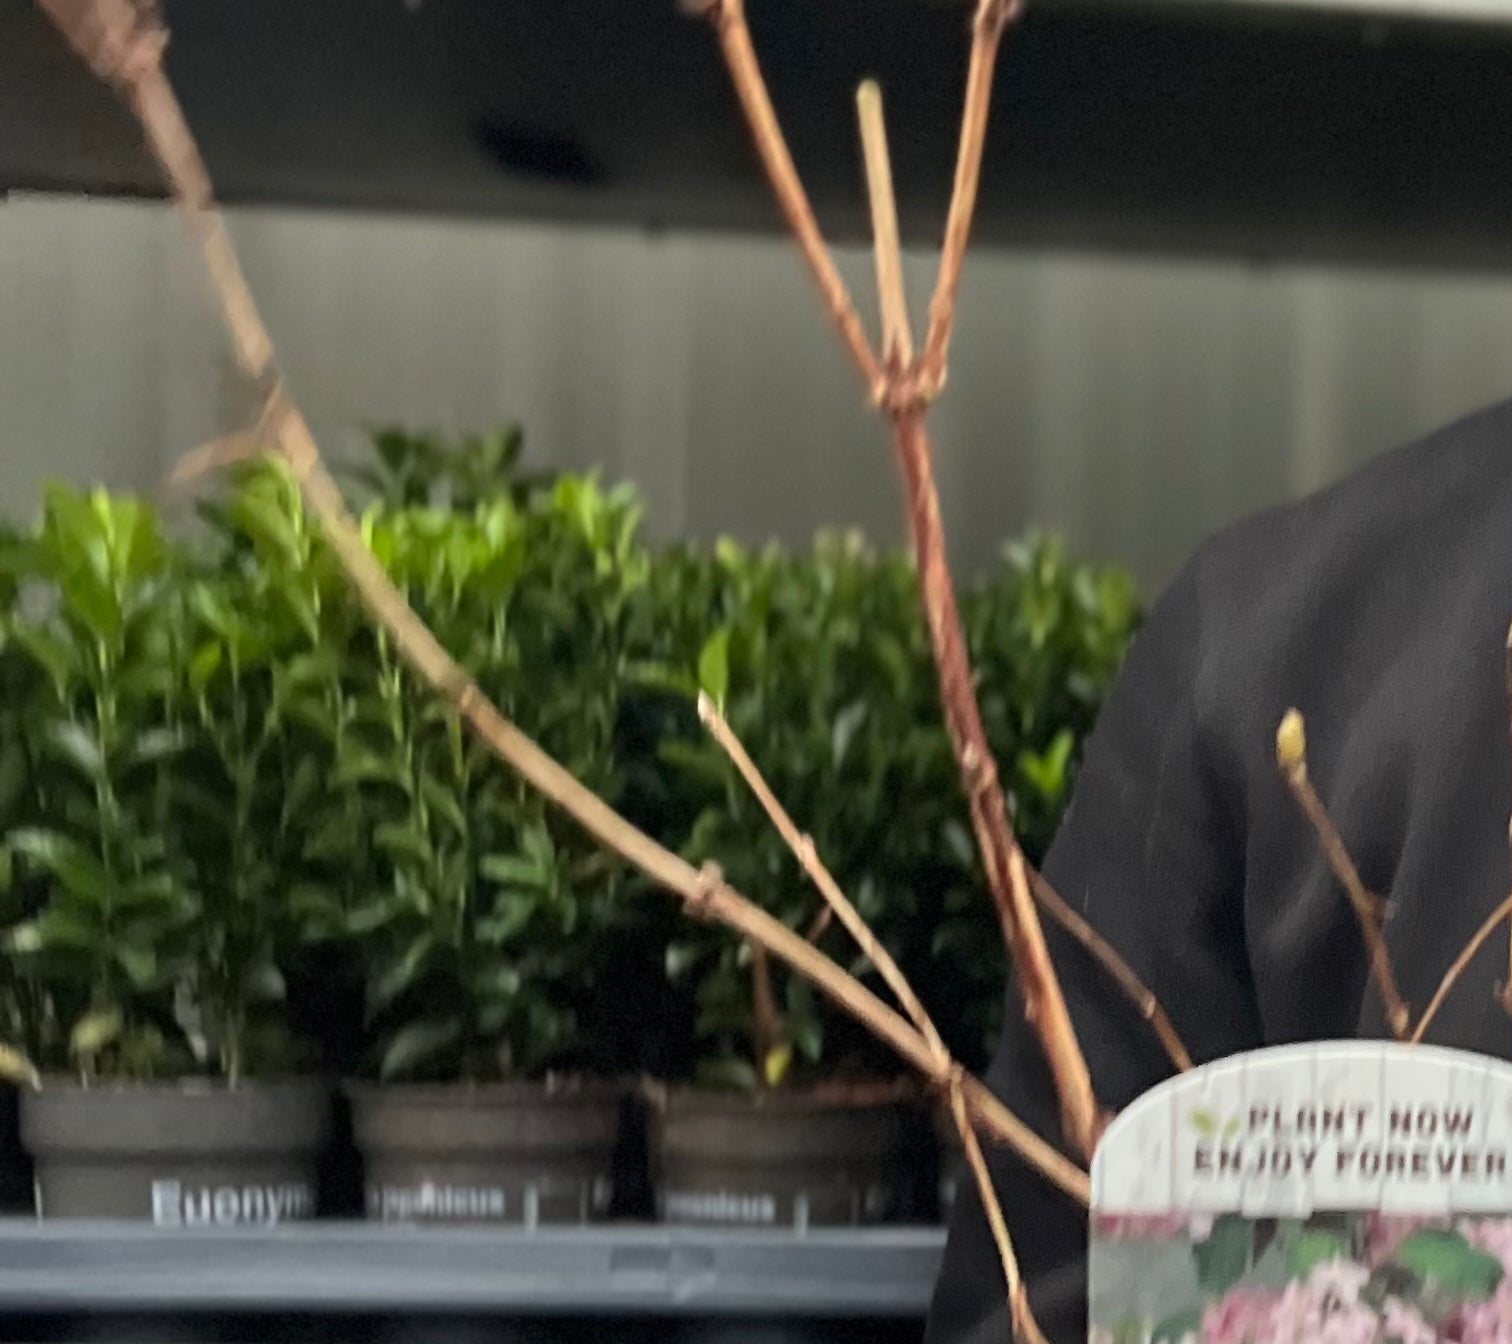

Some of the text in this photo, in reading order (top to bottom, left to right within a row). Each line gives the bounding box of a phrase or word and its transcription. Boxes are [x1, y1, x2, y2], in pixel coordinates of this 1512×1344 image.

[1248, 1105, 1473, 1138] PLANT NOW
[1193, 1146, 1507, 1178] ENJOY FOREVER
